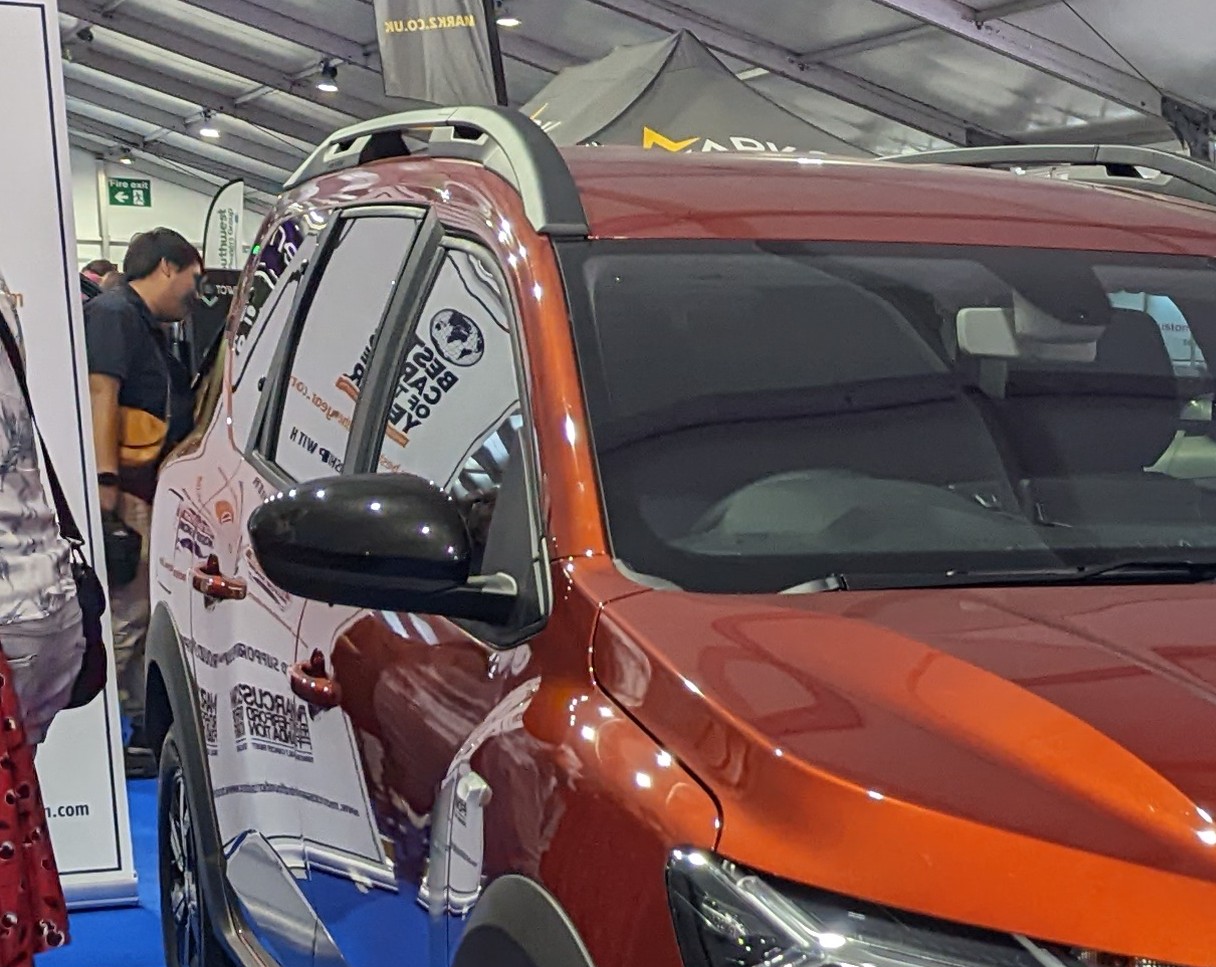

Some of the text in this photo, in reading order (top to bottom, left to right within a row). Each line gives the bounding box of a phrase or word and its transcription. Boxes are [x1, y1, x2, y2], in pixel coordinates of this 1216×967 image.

[109, 180, 149, 190] Fire exit
[217, 208, 228, 268] uthwest
